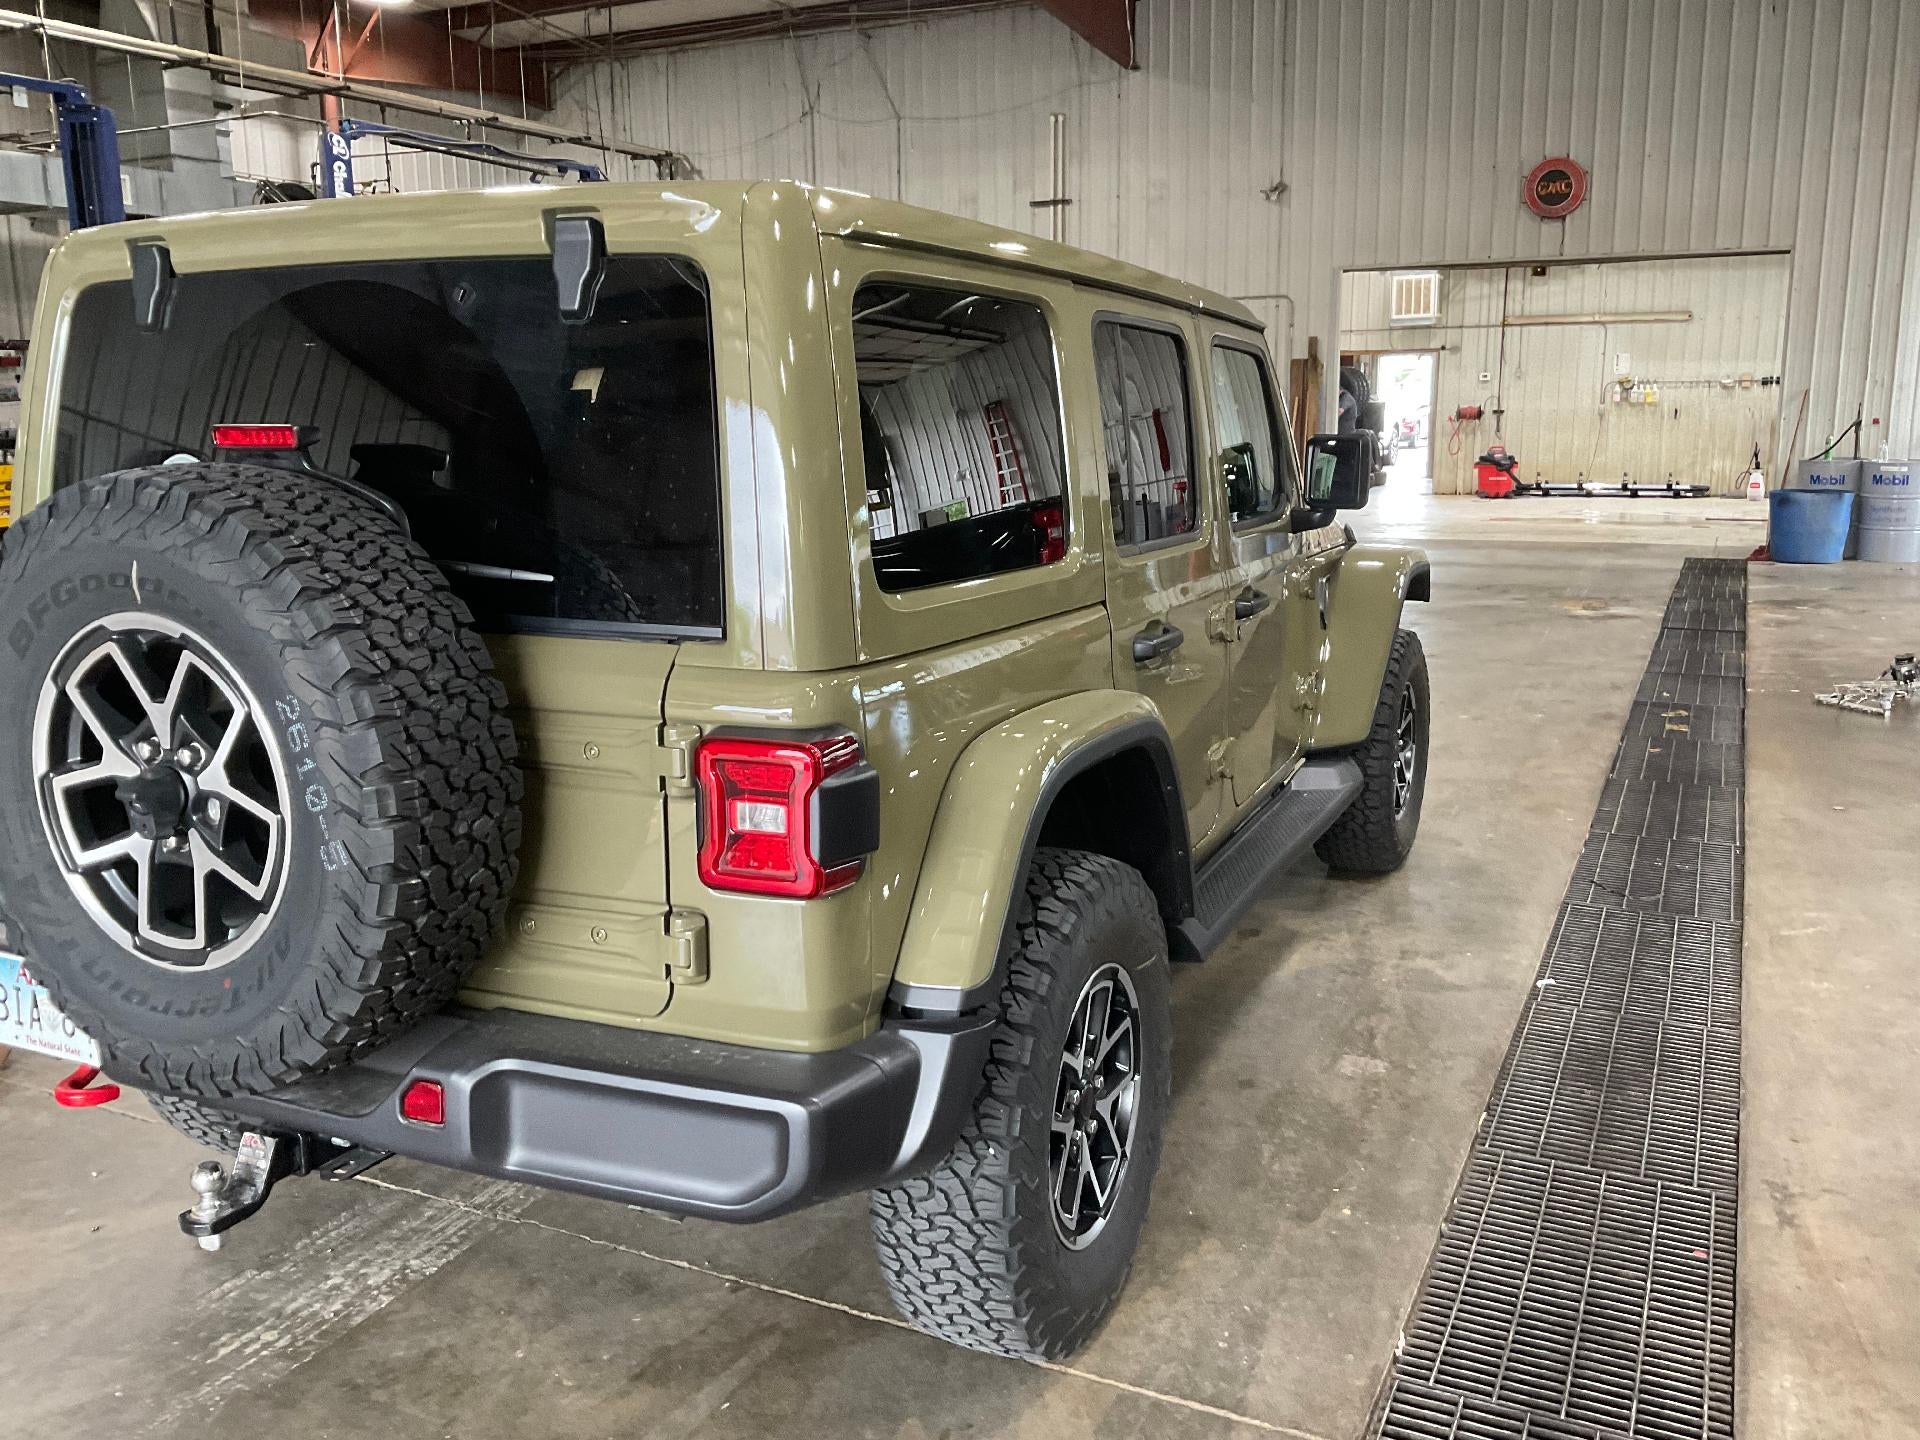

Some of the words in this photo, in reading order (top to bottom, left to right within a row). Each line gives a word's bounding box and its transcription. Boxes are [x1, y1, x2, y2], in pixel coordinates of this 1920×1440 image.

[1537, 180, 1572, 195] GMC
[1810, 474, 1846, 486] Mobil
[1872, 474, 1910, 486] Mobil
[25, 1035, 38, 1045] The
[38, 1038, 63, 1052] Natural
[63, 1044, 82, 1057] State
